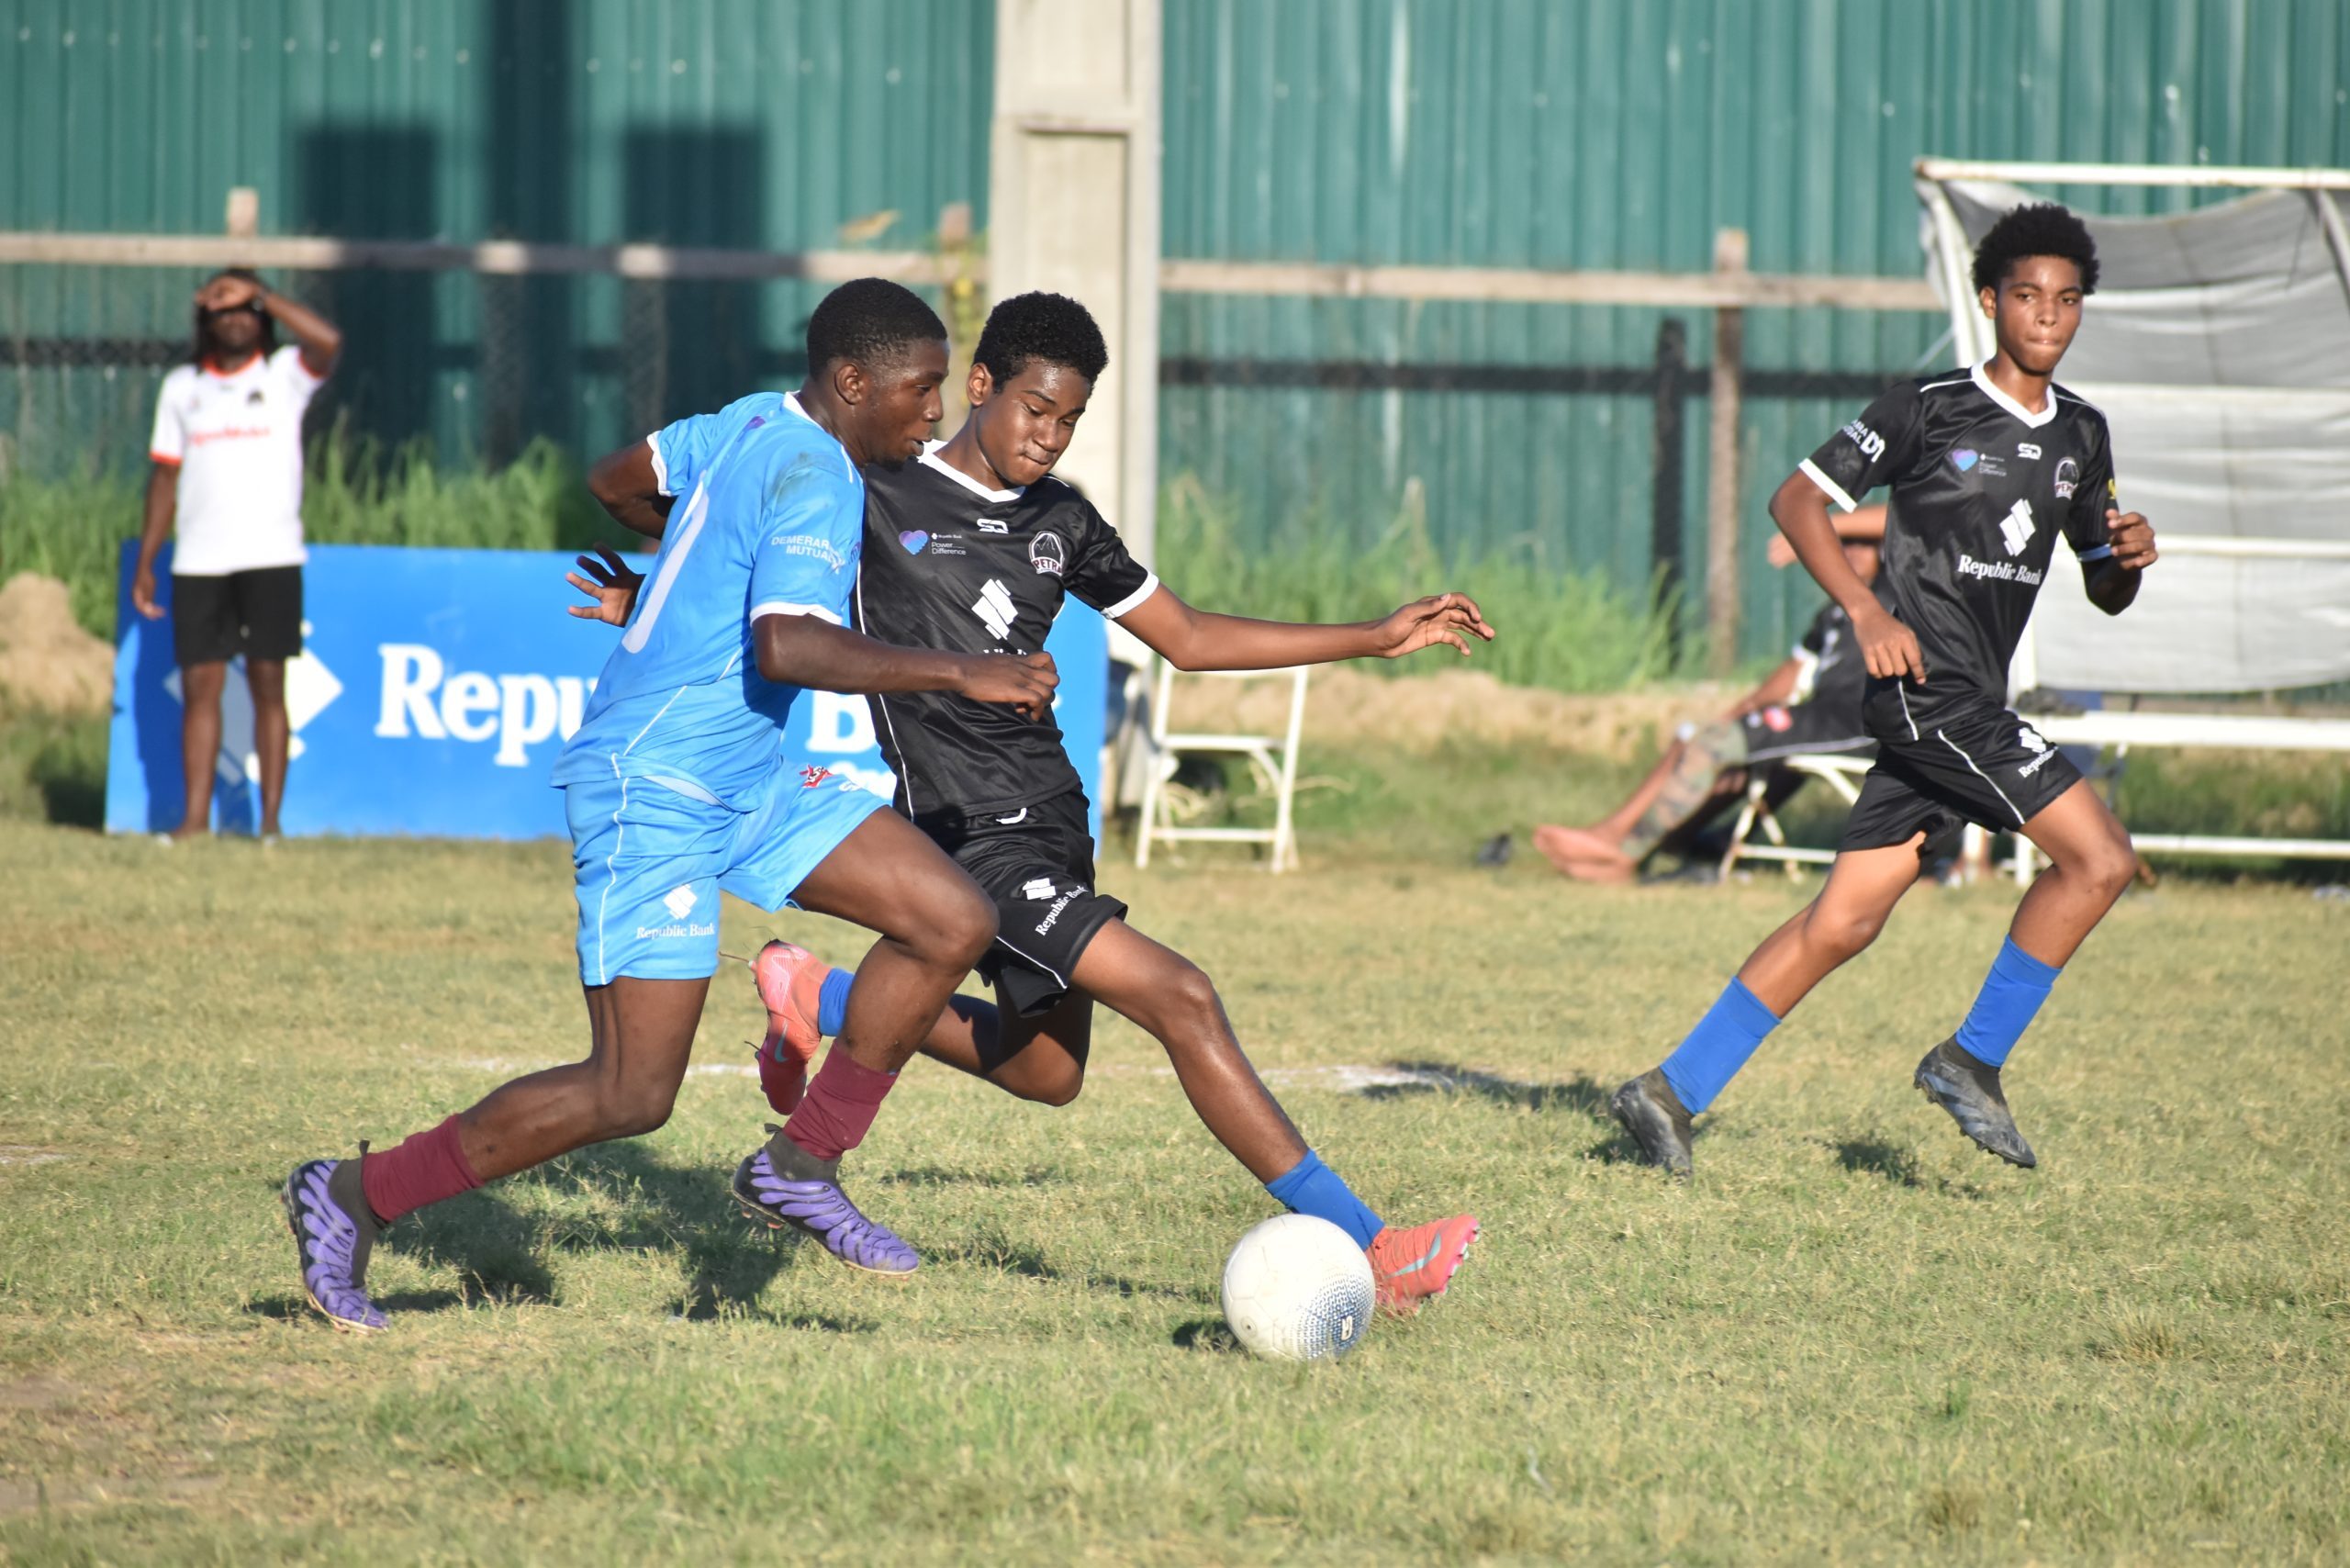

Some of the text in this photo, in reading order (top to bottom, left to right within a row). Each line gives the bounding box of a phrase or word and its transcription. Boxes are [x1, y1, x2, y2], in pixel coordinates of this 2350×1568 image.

[931, 541, 954, 549] Power
[1957, 553, 2017, 581] Republic
[373, 642, 599, 768] Repu
[1035, 896, 1070, 936] Republic
[635, 922, 716, 940] Republic Bank
